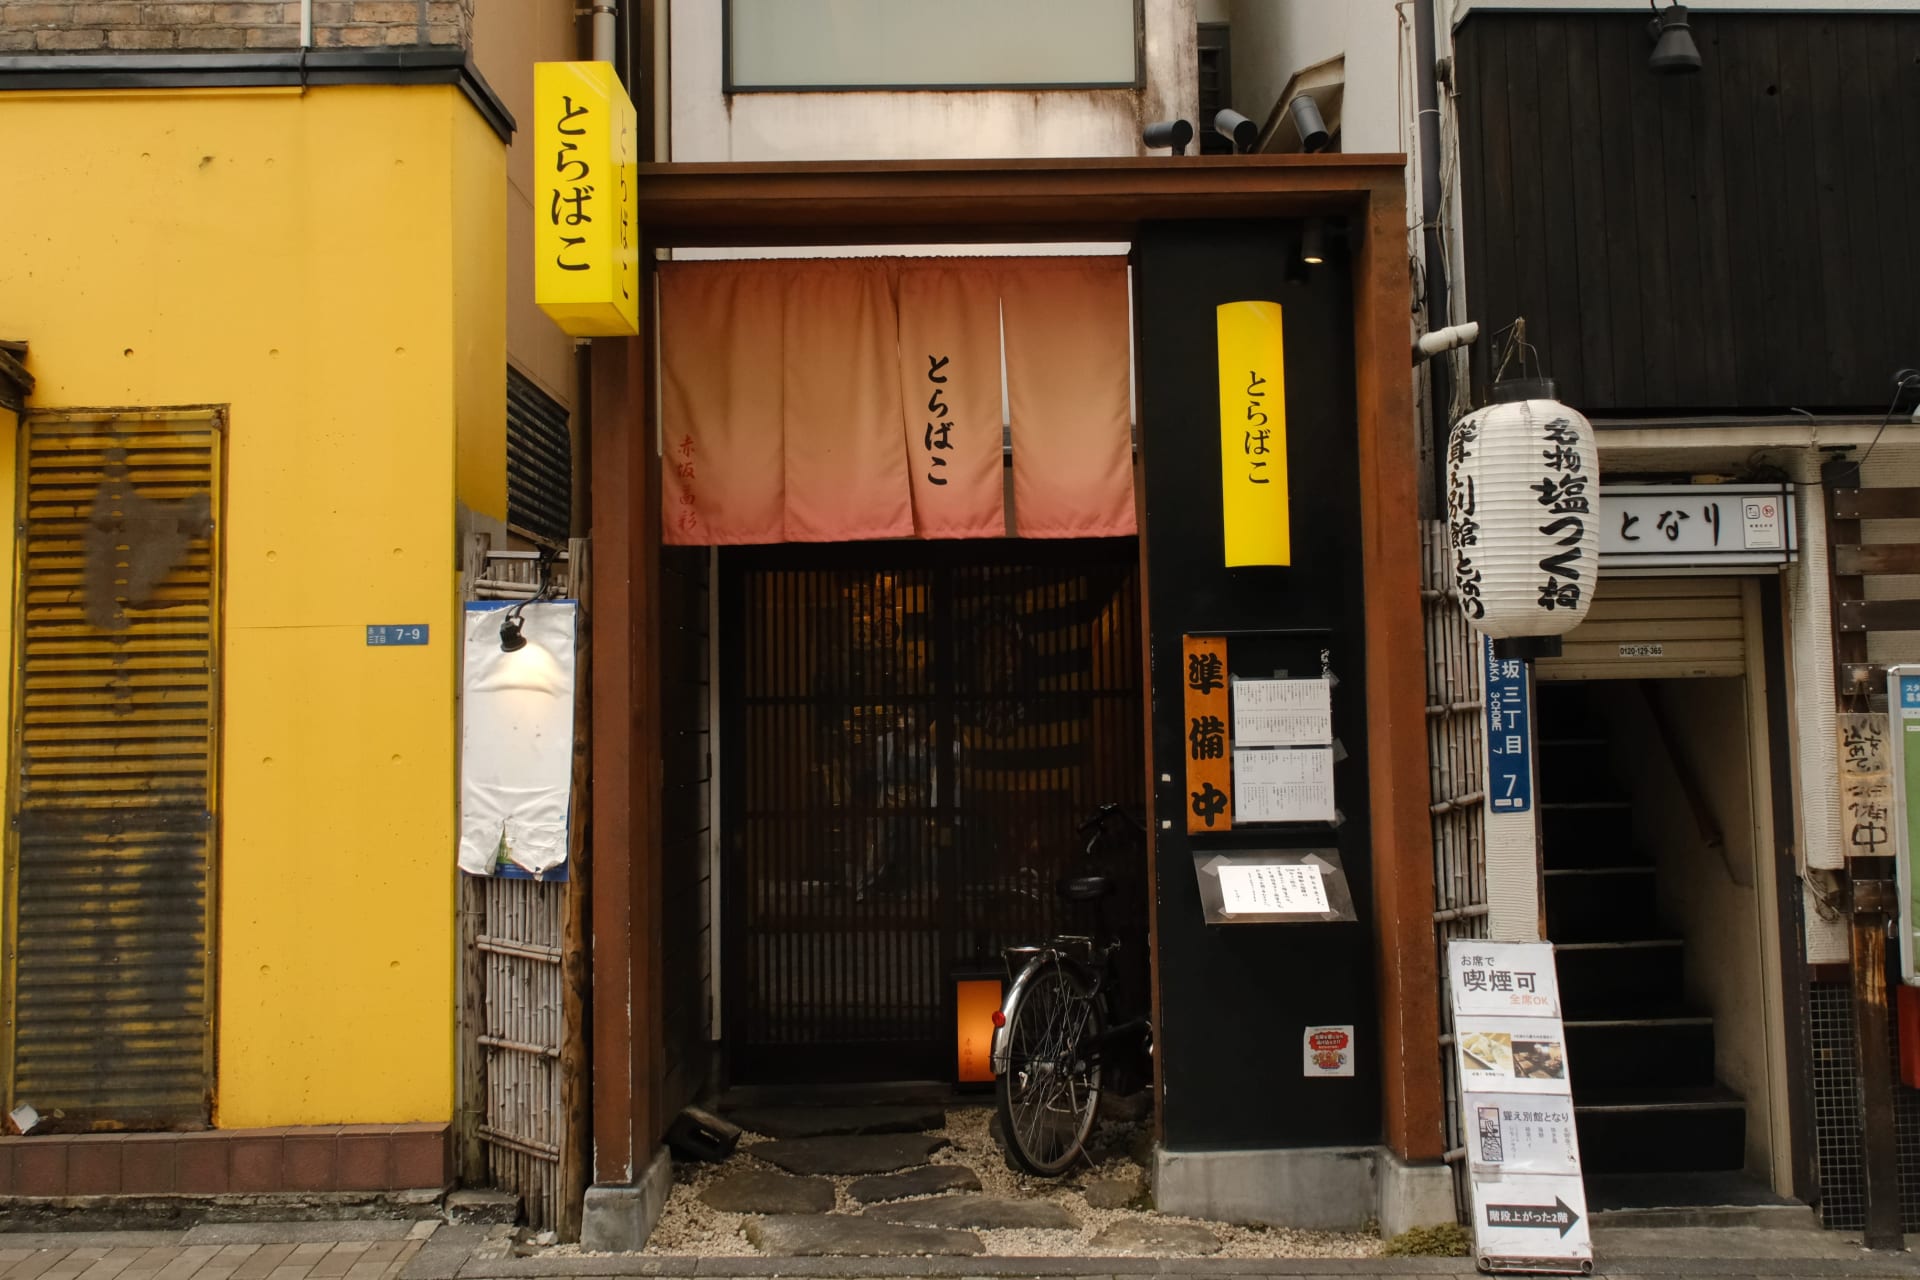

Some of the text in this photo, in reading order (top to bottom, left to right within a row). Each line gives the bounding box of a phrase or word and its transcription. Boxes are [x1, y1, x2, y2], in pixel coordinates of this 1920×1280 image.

[551, 96, 595, 271] とらばこ
[924, 354, 954, 486] とらばこ
[1245, 370, 1271, 484] とらばこ
[1621, 502, 1720, 547] となり
[395, 628, 420, 640] 7-9
[1490, 691, 1502, 732] 3-CHOME
[1502, 660, 1522, 755] 坂三丁目
[1189, 652, 1228, 828] 準備中
[1492, 747, 1503, 755] 7
[1503, 774, 1517, 798] 7
[1461, 955, 1495, 968] お席で
[1463, 969, 1537, 993] 喫煙可
[1509, 994, 1549, 1006] 全席OK
[1489, 1209, 1569, 1224] 階段上がった2階
